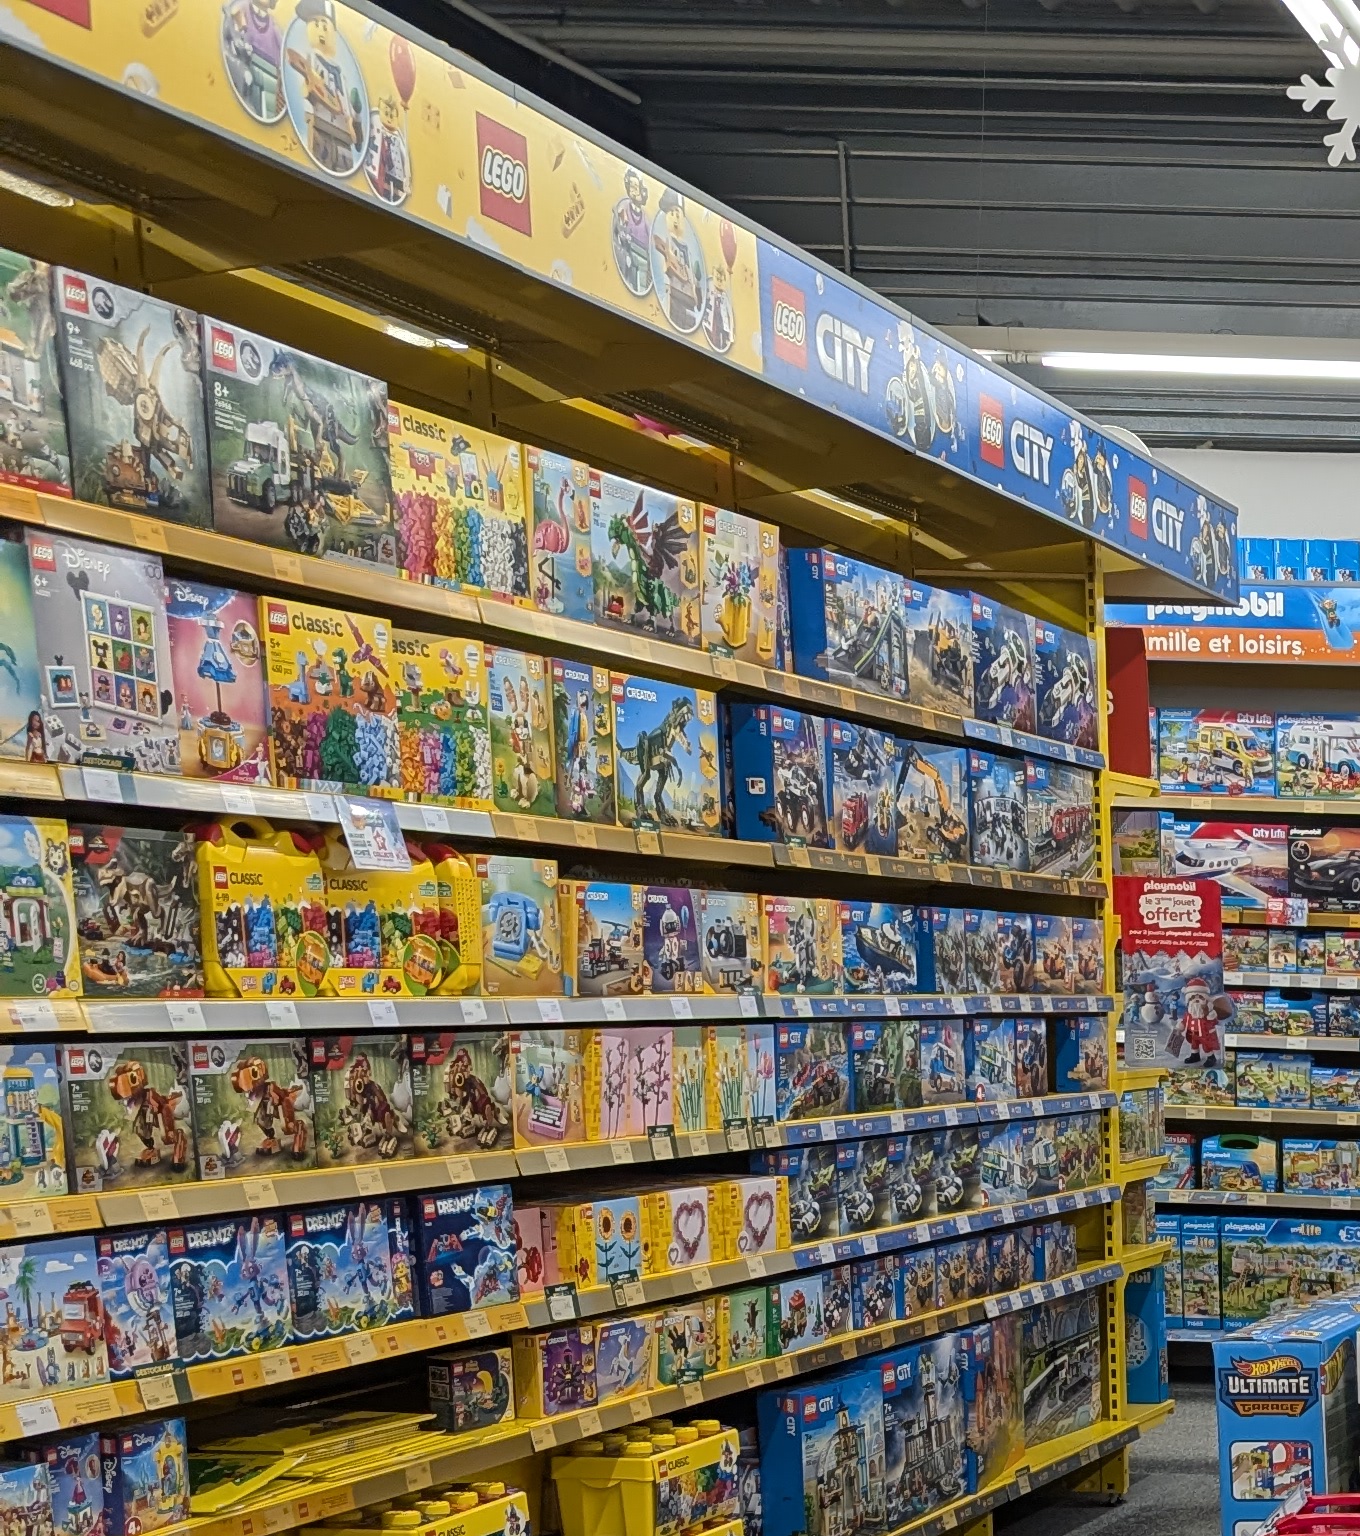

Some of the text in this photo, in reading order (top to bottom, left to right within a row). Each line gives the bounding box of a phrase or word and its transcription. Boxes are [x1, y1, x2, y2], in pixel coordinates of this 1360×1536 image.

[481, 147, 529, 201] LEGO
[773, 299, 875, 394] LEGO CITY
[980, 412, 1054, 486] LEGO CITY
[1130, 490, 1184, 552] LEGO CITY
[268, 610, 288, 628] LEGO
[1209, 633, 1302, 656] et loisirs
[1144, 881, 1196, 892] playmobil
[897, 1363, 912, 1381] CITY
[1227, 1376, 1310, 1395] ULTIMATE
[818, 1396, 834, 1414] CITY
[1240, 1401, 1302, 1414] GARAGE
